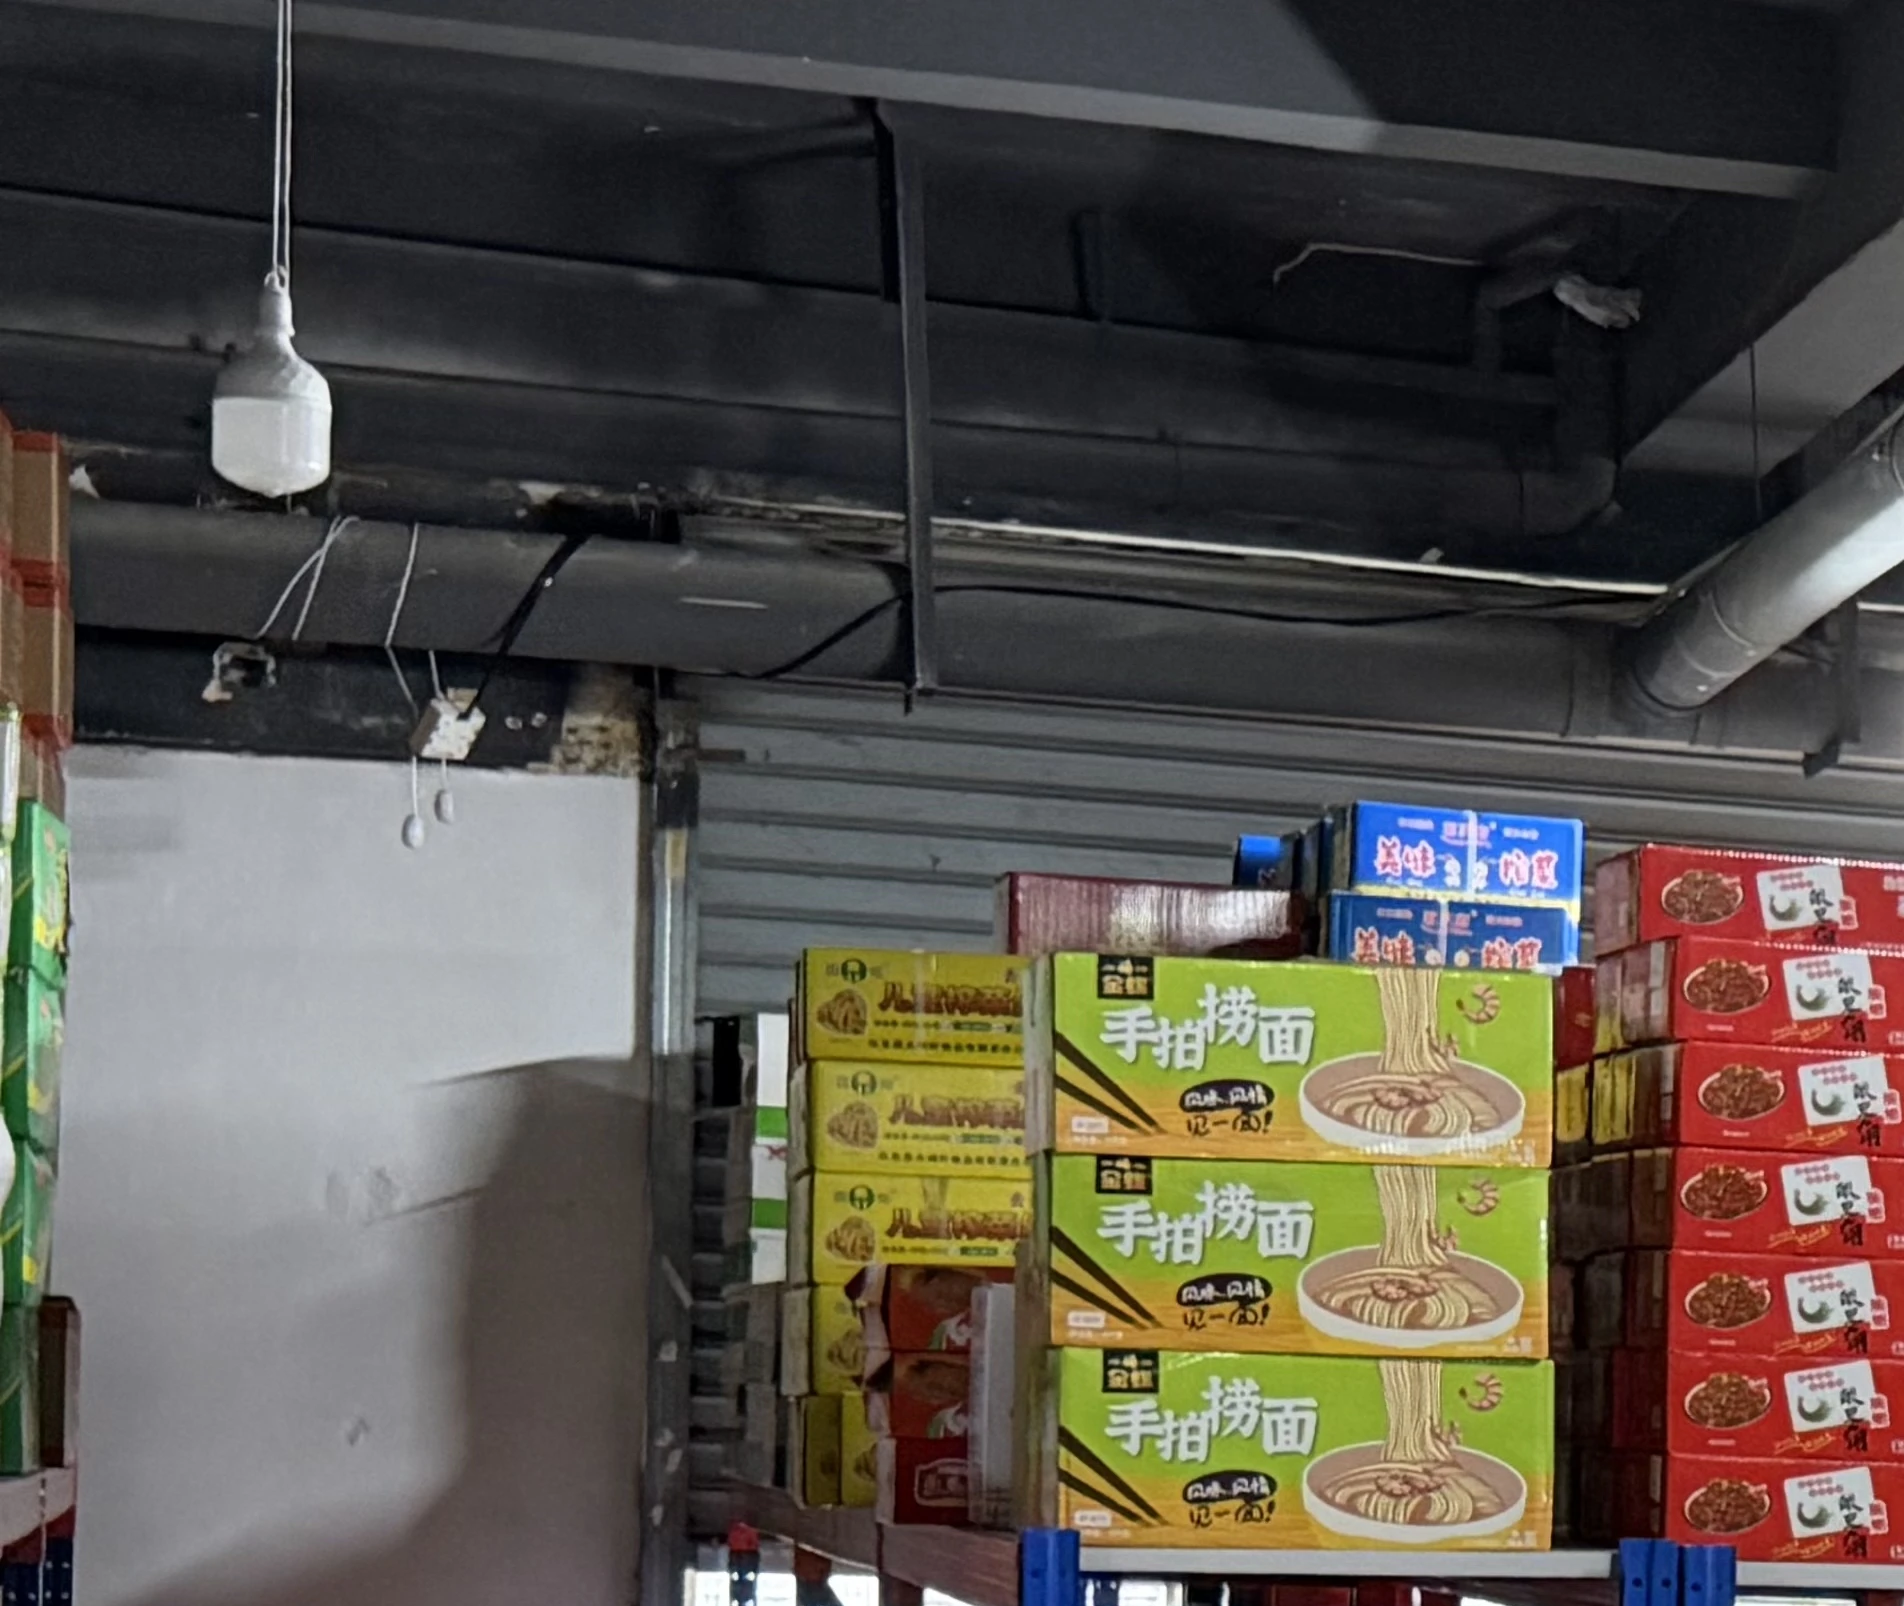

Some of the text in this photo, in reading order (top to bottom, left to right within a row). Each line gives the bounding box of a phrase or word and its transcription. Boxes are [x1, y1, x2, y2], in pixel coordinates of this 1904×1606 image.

[1099, 983, 1315, 1071] 手拍捞面
[1097, 1180, 1315, 1266] 手拍捞面
[1104, 1376, 1319, 1464] 手拍捞面
